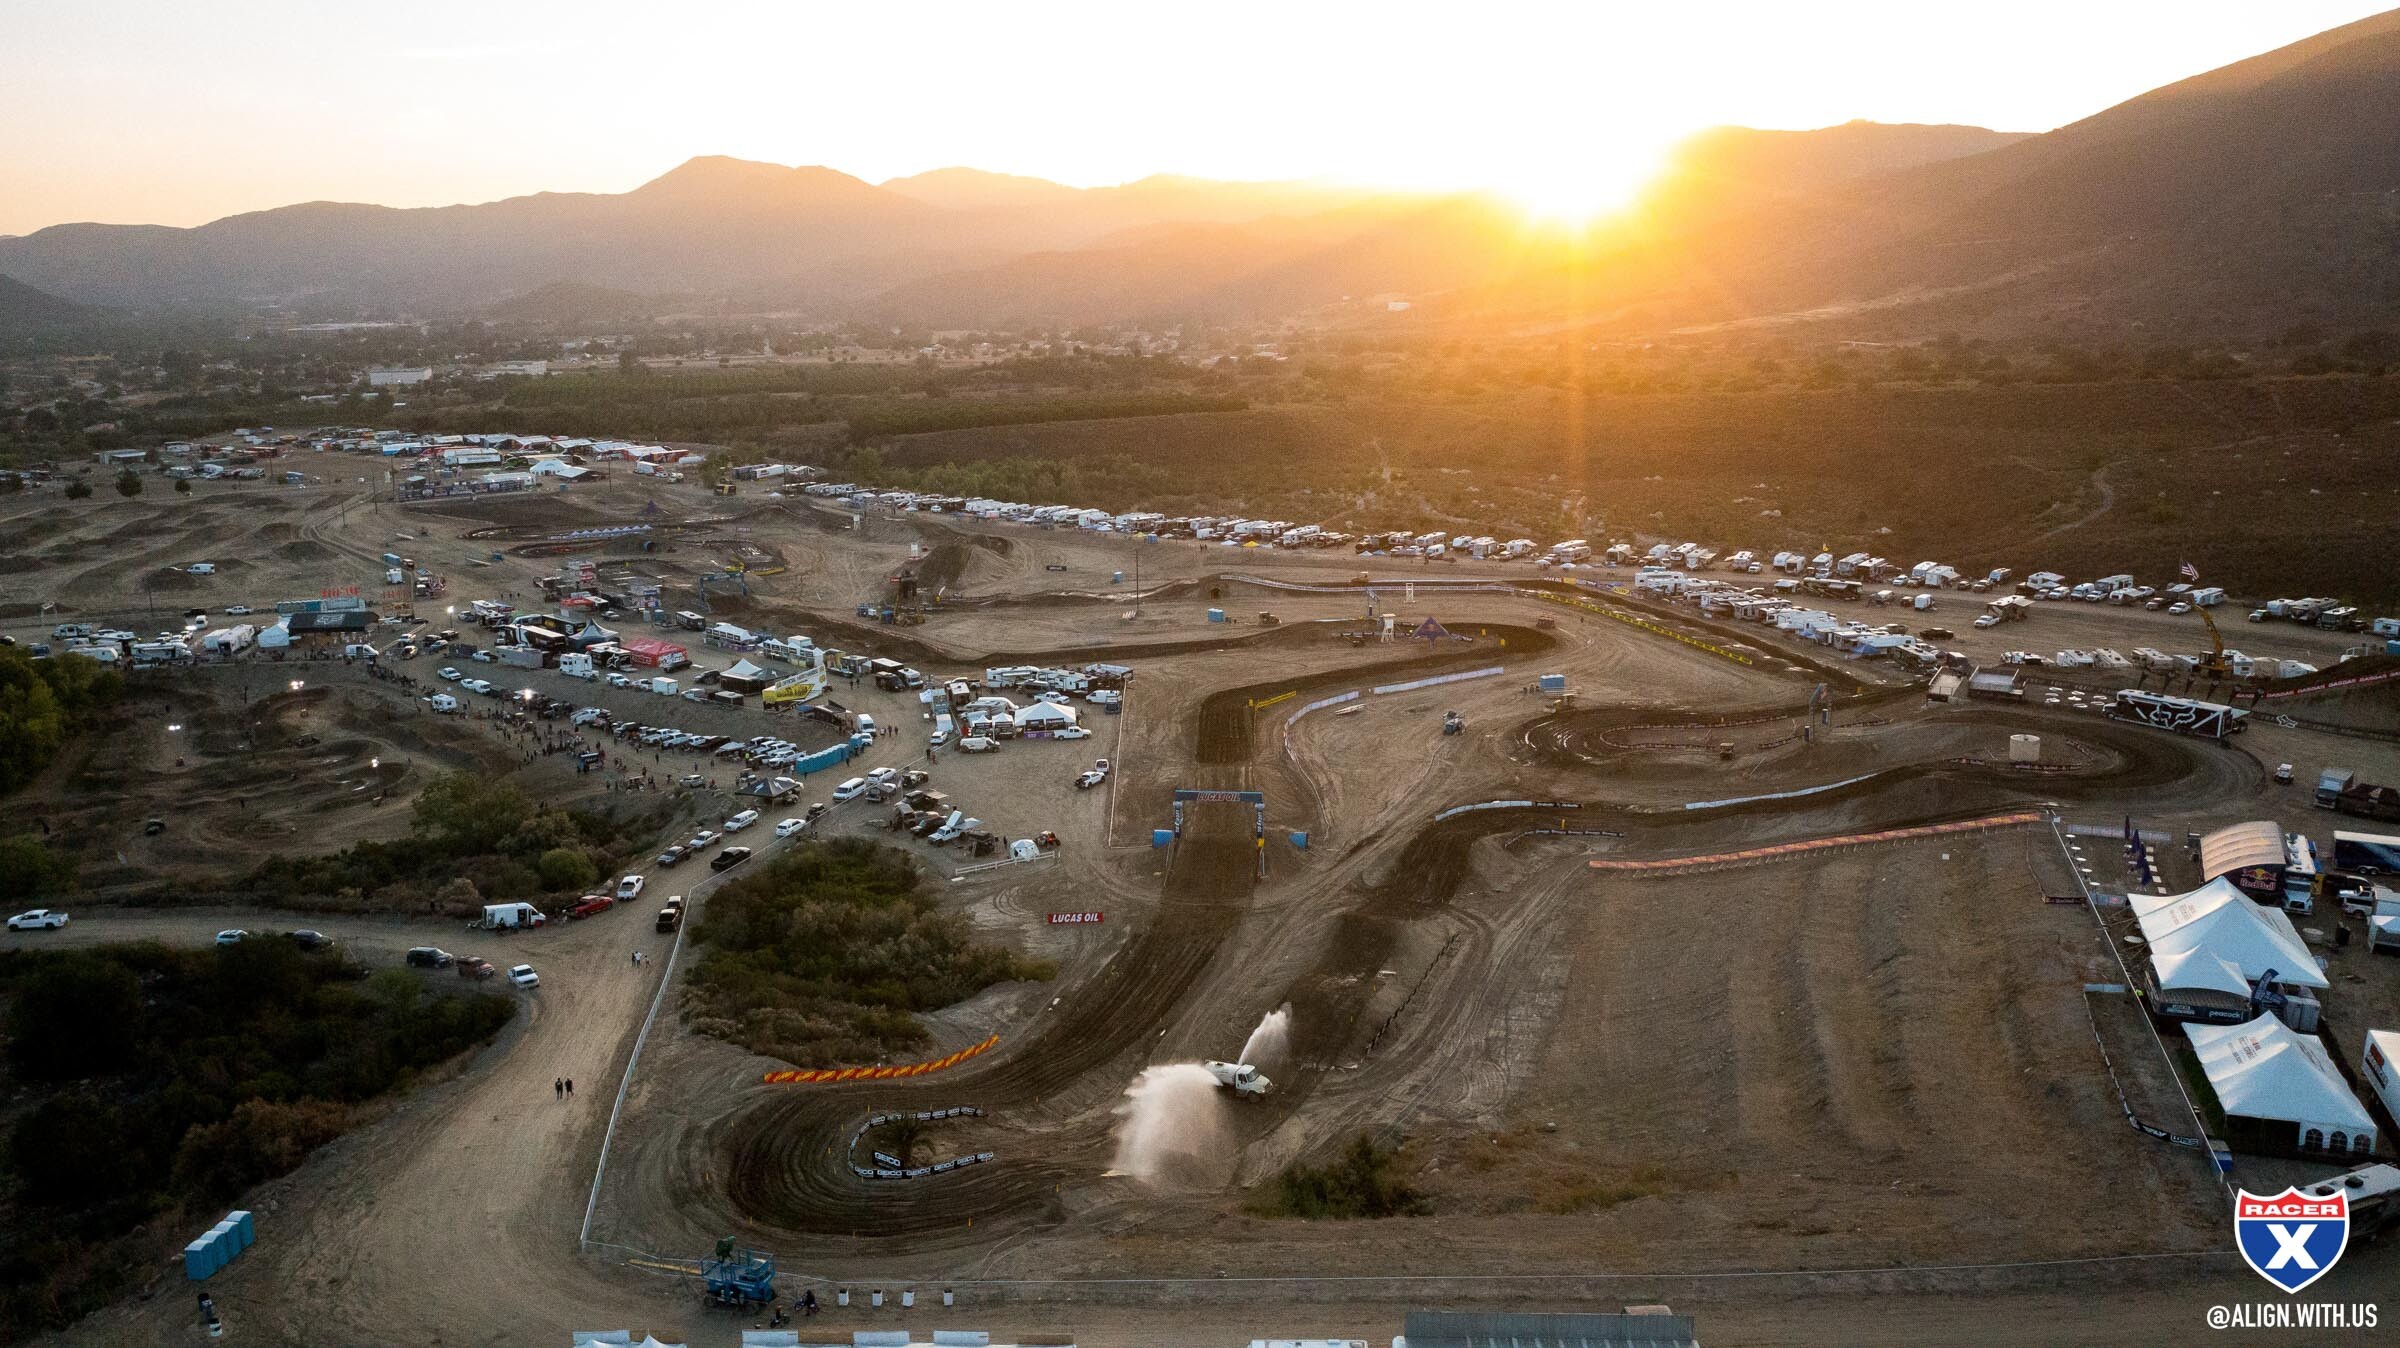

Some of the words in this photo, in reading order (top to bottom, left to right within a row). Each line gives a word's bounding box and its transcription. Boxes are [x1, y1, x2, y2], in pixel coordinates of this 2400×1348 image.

[1197, 792, 1225, 801] LUCAS
[1226, 792, 1241, 801] OIL
[2240, 878, 2259, 889] Red
[2260, 880, 2276, 891] Bull
[1052, 913, 1082, 923] LUCAS
[1084, 913, 1099, 922] OIL
[2209, 1010, 2241, 1018] peacock
[874, 1151, 901, 1166] GEICO
[957, 1155, 976, 1165] GEICO
[934, 1161, 954, 1171] GEICO
[906, 1167, 931, 1176] GEICO
